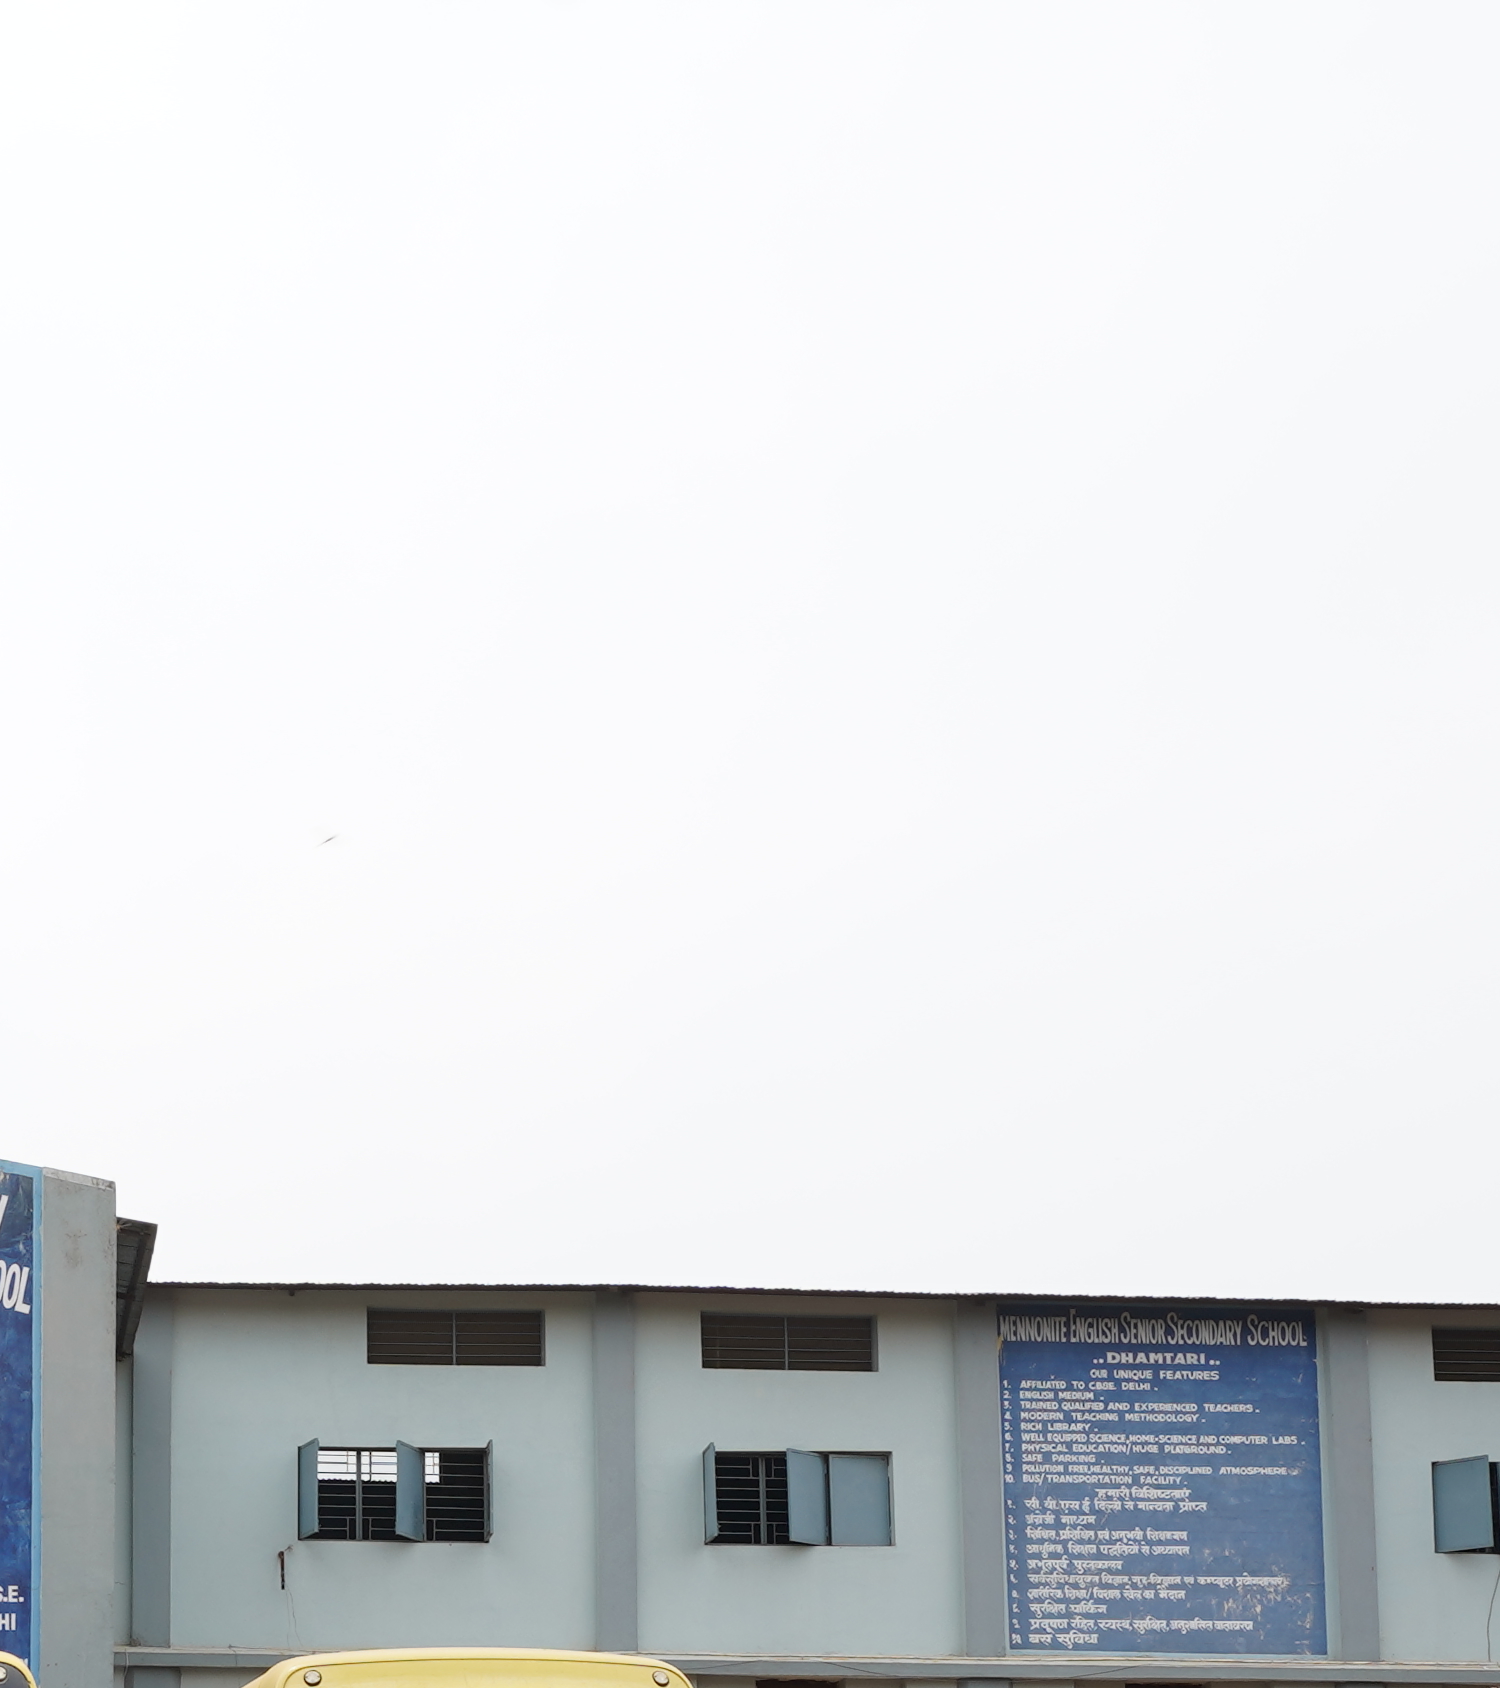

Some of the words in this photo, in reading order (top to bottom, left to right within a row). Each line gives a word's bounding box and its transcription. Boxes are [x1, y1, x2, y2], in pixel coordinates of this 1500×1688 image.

[1000, 1315, 1067, 1342] MENNONITE
[1070, 1309, 1118, 1344] ENGLISH
[1120, 1312, 1165, 1344] SENIOR
[1167, 1312, 1242, 1345] SECONDARY
[1247, 1314, 1307, 1346] SCHOOL
[1090, 1369, 1108, 1378] OUR
[1113, 1369, 1153, 1380] UNIQUE
[1159, 1370, 1220, 1381] FEATURES
[1020, 1380, 1067, 1389] AFFILIATED
[1071, 1381, 1085, 1389] TO
[1020, 1391, 1054, 1399] ENGLISH
[1020, 1401, 1059, 1410] TRAINED
[1061, 1402, 1104, 1411] QUALIFIED
[1107, 1402, 1130, 1411] AND
[1134, 1403, 1198, 1412] EXPERIENCED
[1020, 1412, 1064, 1420] MODERN
[1071, 1413, 1118, 1421] TEACHING
[1020, 1423, 1042, 1431] RICH
[1021, 1433, 1045, 1441] WELL
[1047, 1434, 1087, 1442] EQUIPPED
[1200, 1436, 1217, 1444] AND
[1219, 1436, 1268, 1444] COMPUTER
[1022, 1444, 1068, 1452] PHYSICAL
[1022, 1454, 1043, 1462] SAFE
[1022, 1464, 1064, 1472] POLLUTION
[1094, 1486, 1130, 1499] हमारी
